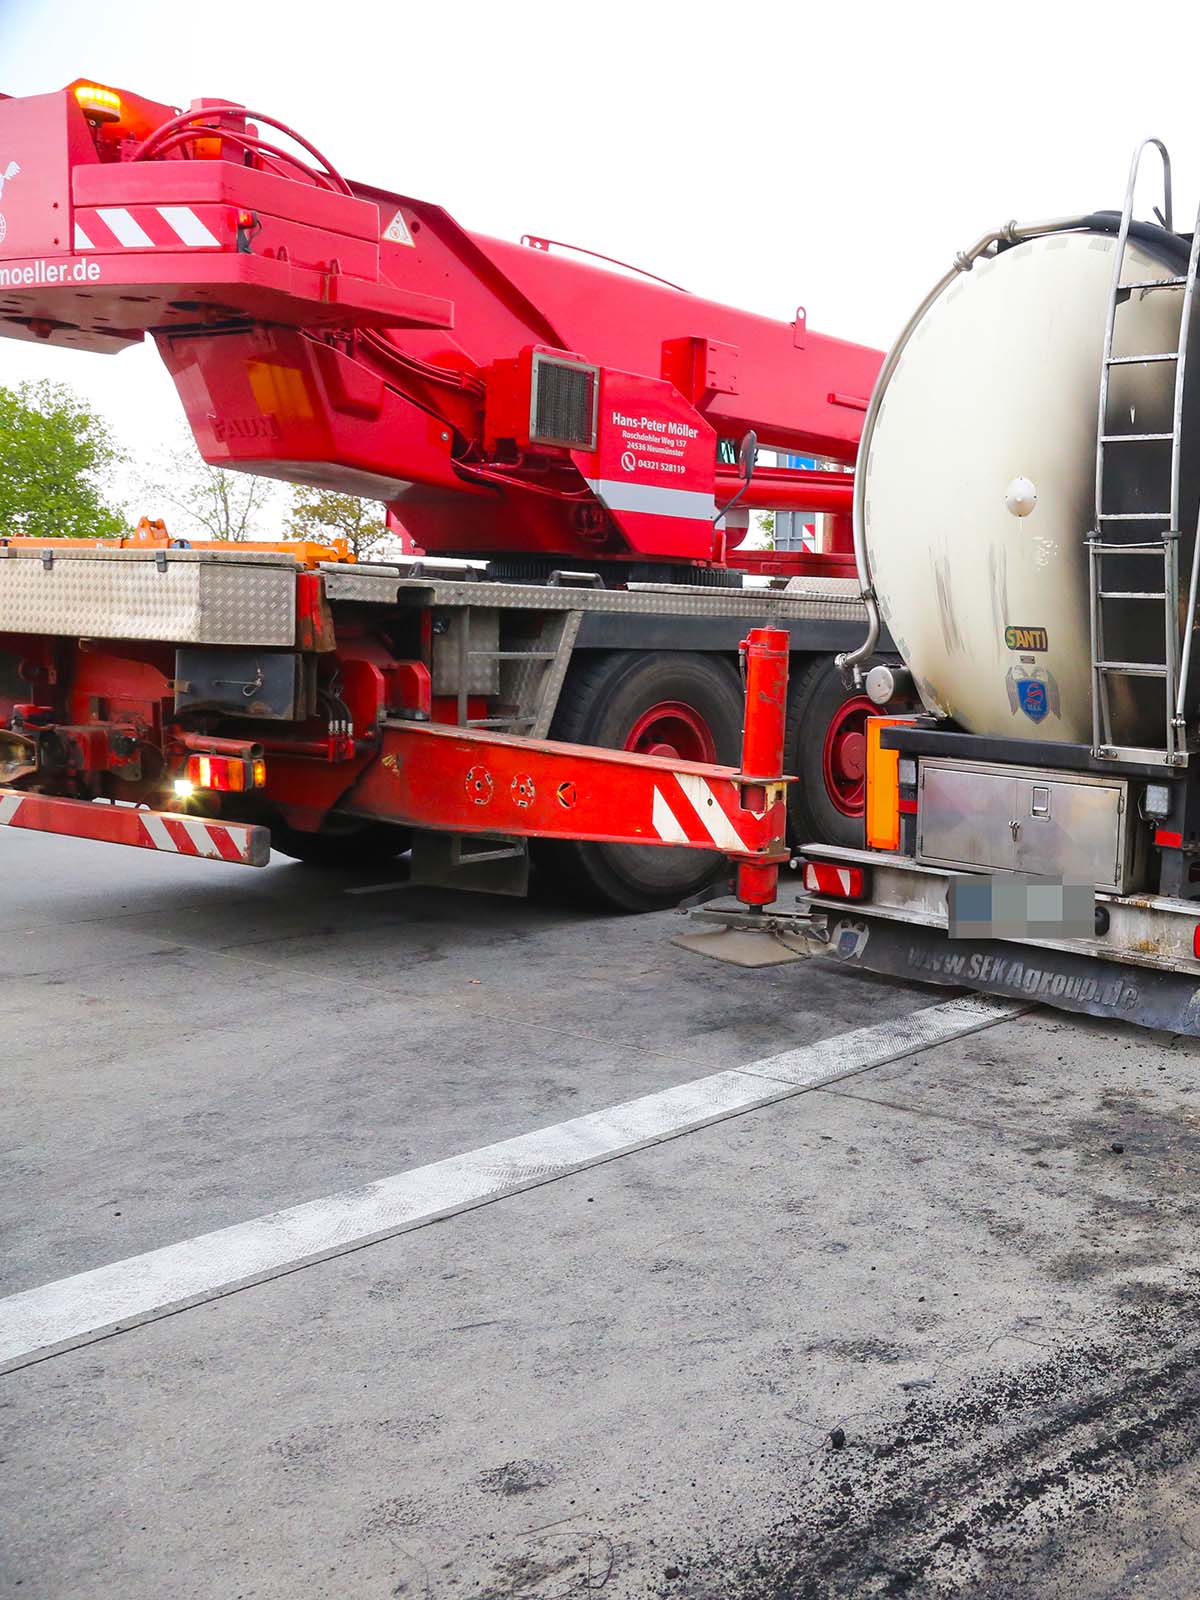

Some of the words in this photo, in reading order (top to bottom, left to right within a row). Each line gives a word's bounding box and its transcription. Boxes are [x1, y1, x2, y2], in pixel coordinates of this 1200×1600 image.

[612, 411, 667, 432] Hans-Peter
[668, 421, 699, 439] Möller
[661, 436, 675, 448] Weg
[676, 439, 687, 447] 157
[646, 445, 684, 456] Neumünster
[638, 459, 659, 470] 04321
[660, 463, 686, 473] 528119
[1007, 629, 1046, 649] SANTI
